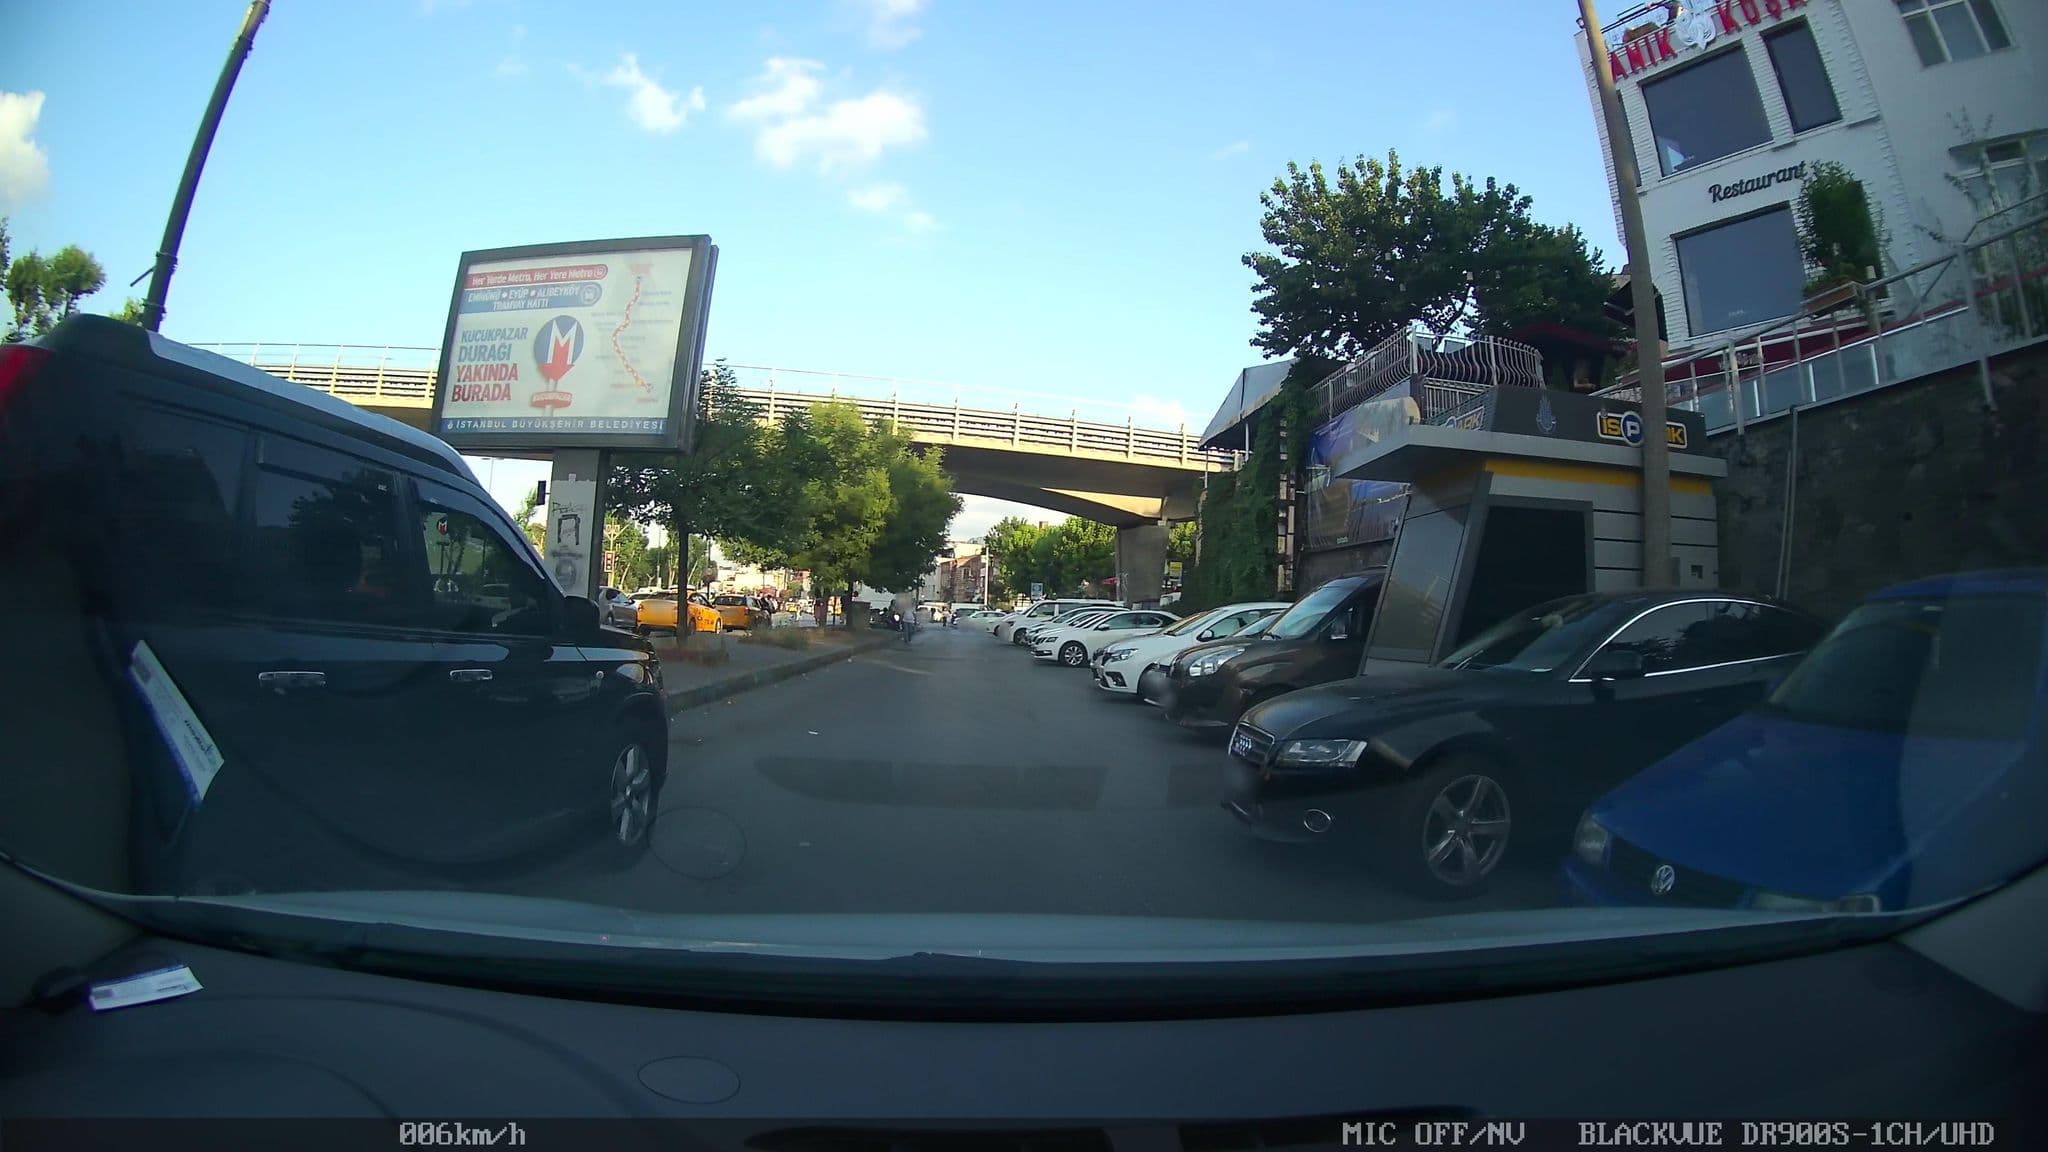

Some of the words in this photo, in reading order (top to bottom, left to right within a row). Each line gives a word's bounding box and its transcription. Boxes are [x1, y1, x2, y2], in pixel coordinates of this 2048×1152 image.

[1708, 160, 1808, 203] Restaurant
[534, 271, 548, 281] Her
[550, 269, 567, 280] Yere
[568, 268, 593, 280] Metro
[458, 343, 512, 362] DURAĞI
[456, 363, 519, 382] YAKINDA
[451, 383, 512, 402] BURADA
